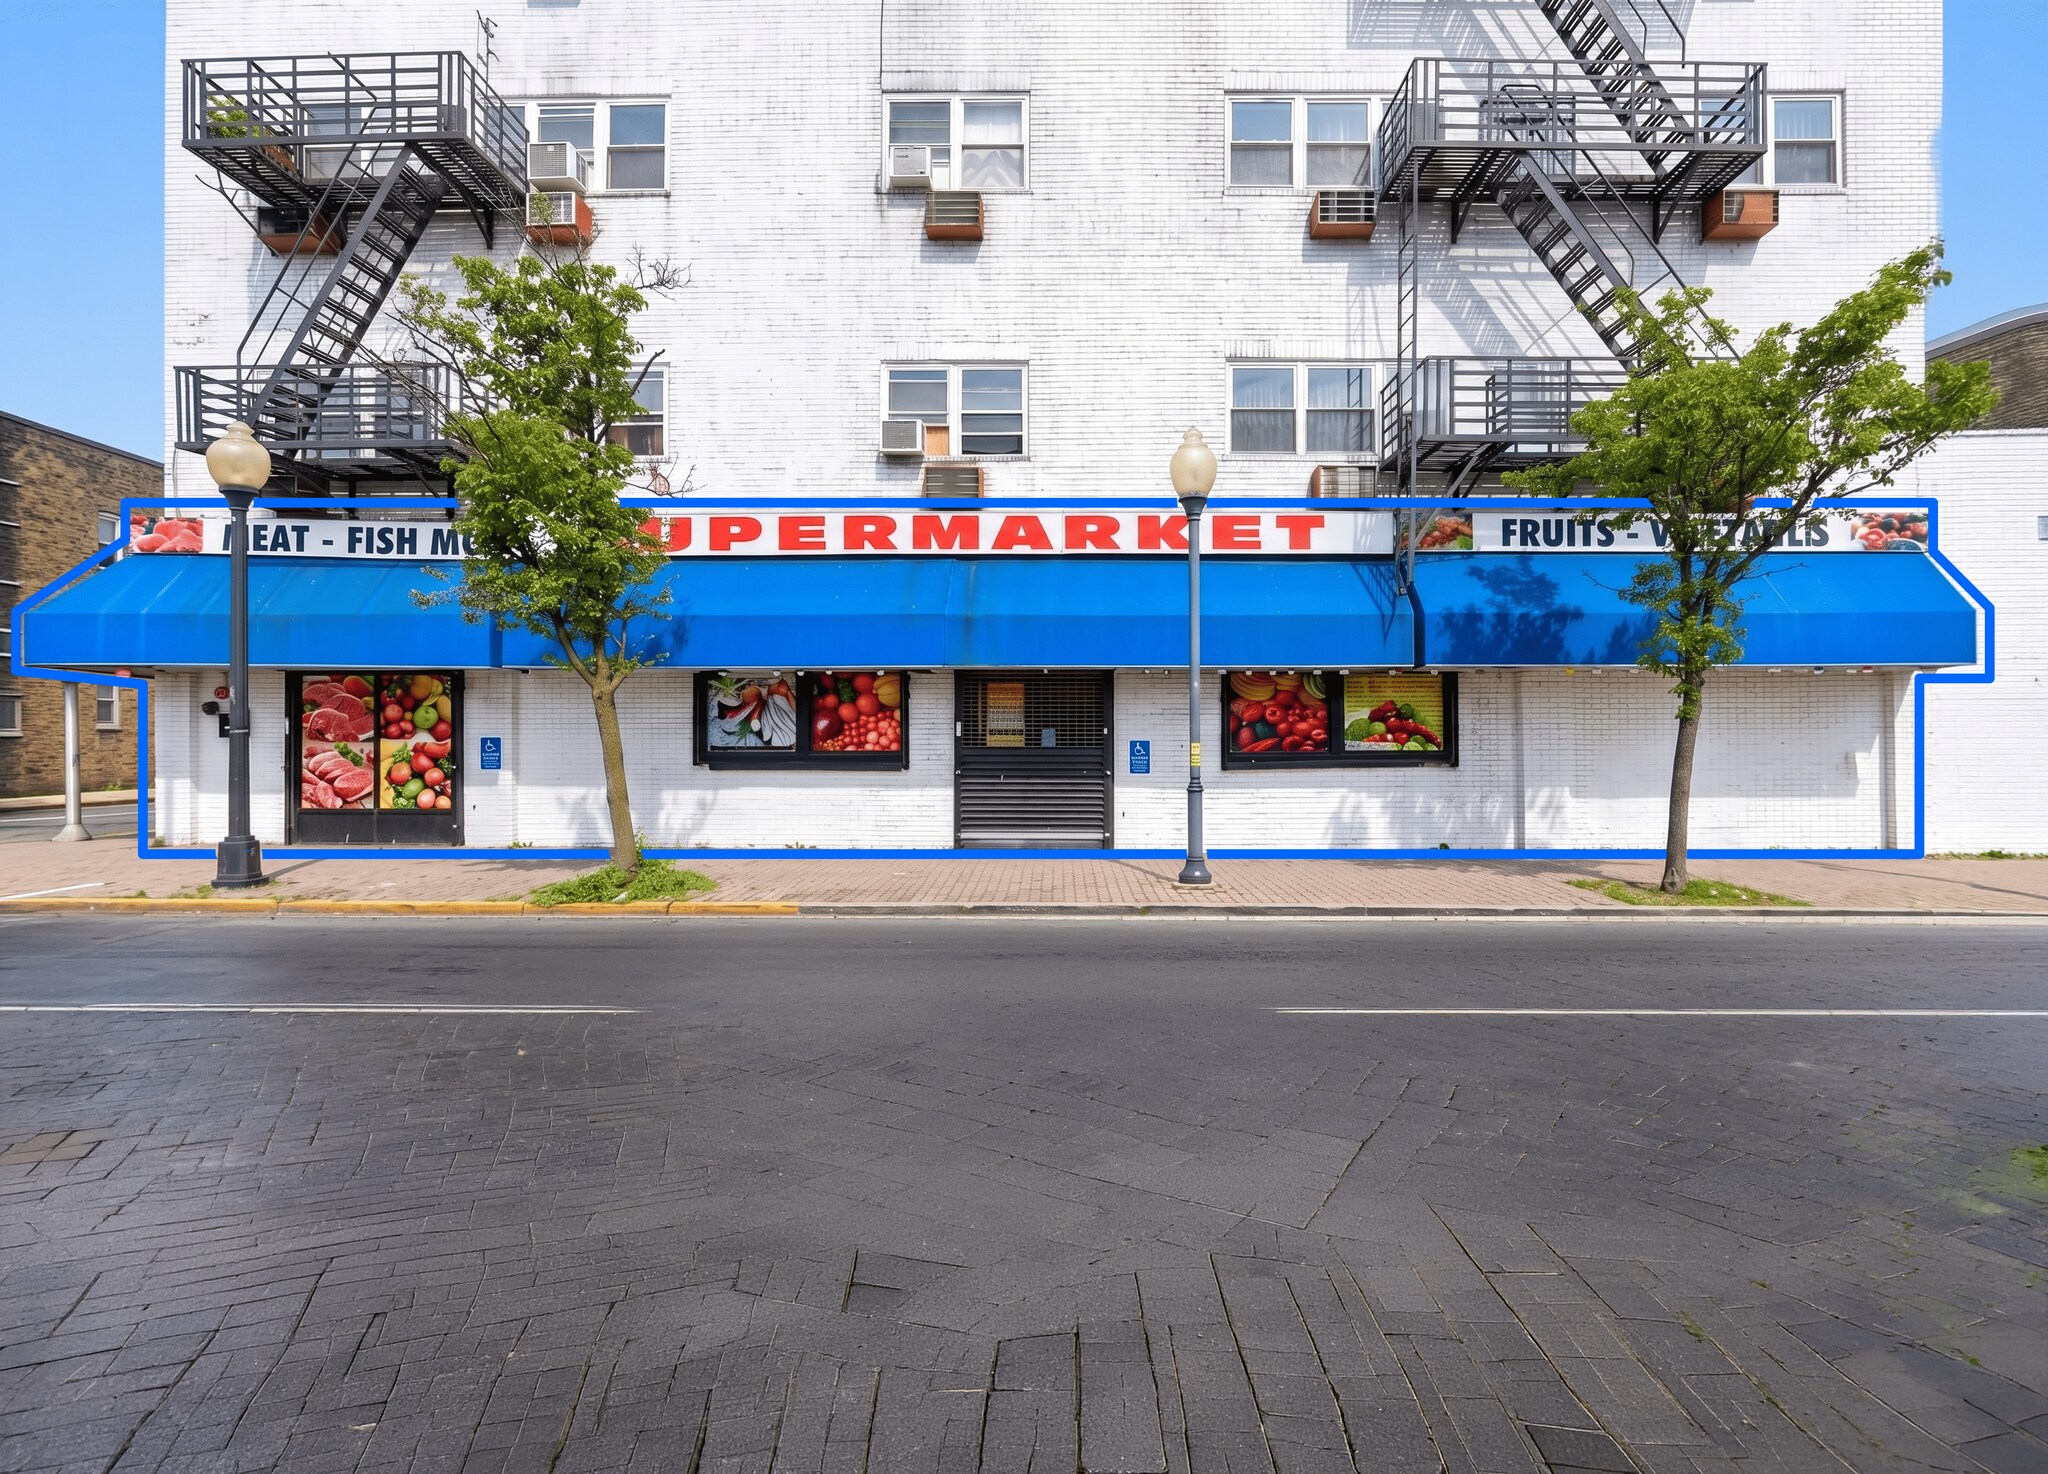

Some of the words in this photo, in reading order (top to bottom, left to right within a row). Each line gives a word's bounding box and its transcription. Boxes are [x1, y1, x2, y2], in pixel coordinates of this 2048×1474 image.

[347, 526, 418, 555] FISH
[616, 514, 1325, 552] UPERMARKET
[1501, 518, 1615, 547] FRUITS
